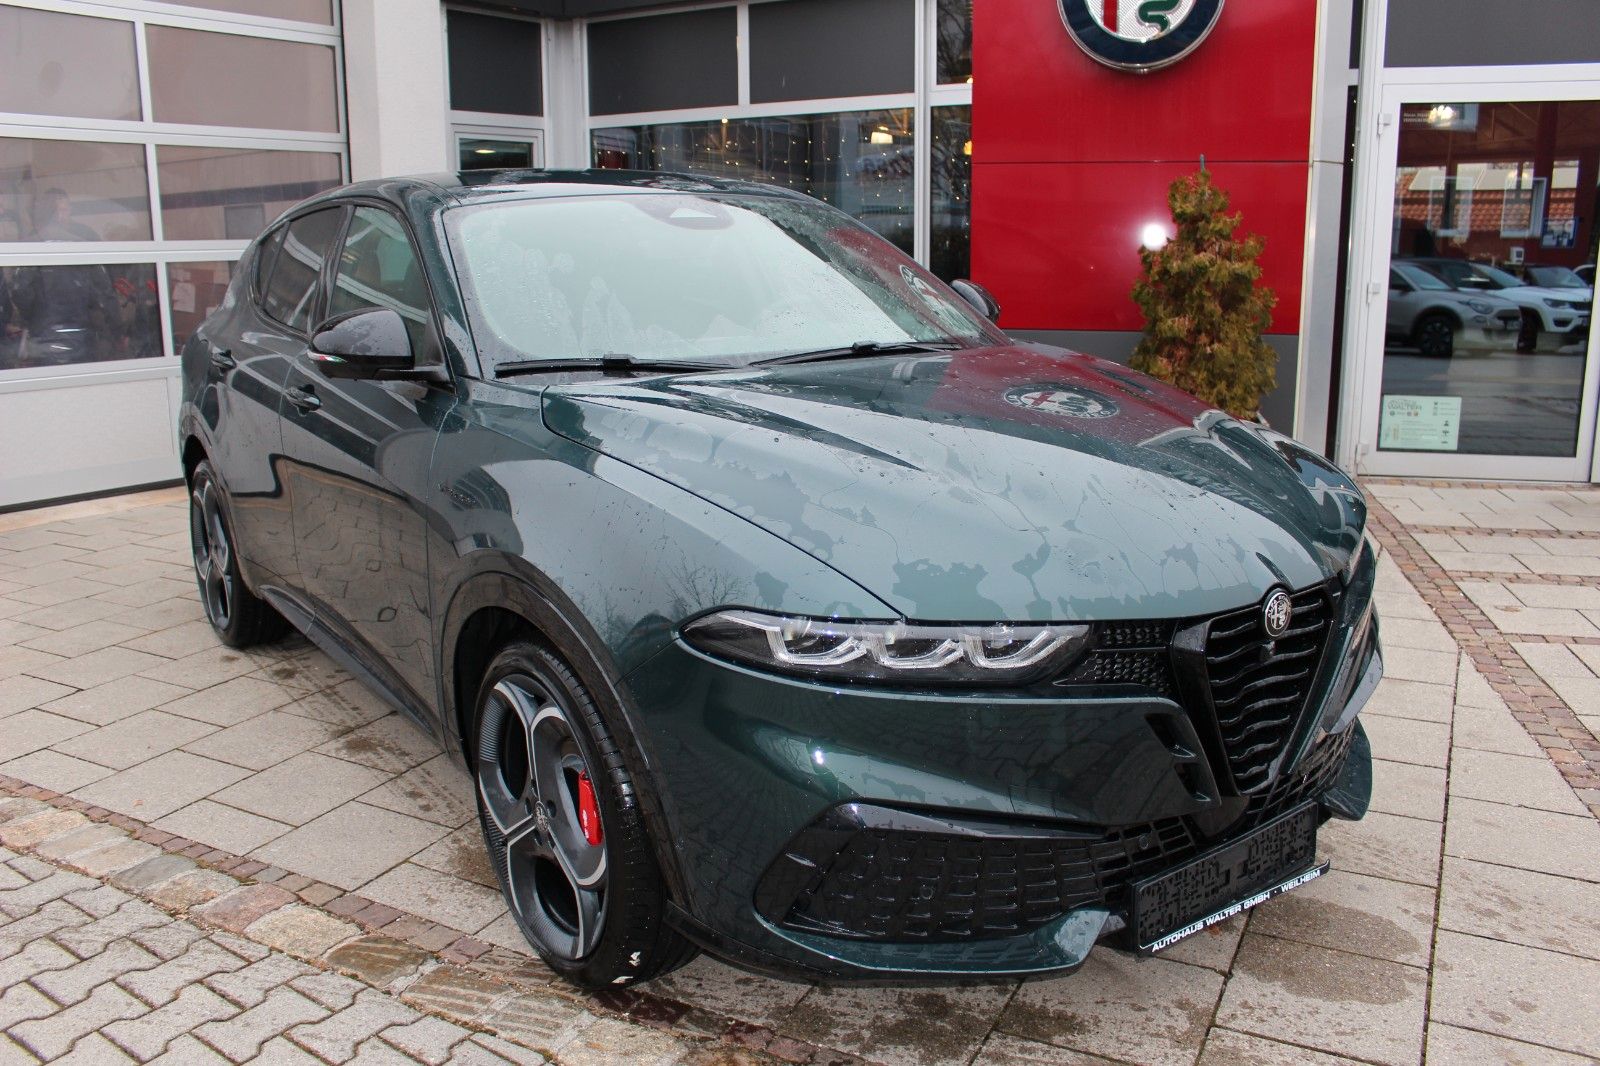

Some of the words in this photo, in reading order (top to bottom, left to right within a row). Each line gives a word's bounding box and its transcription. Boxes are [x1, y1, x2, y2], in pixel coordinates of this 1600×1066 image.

[1152, 922, 1204, 952] AUTOHAUS
[1205, 905, 1242, 926] WALTER
[1243, 892, 1271, 909] GMBH
[1281, 869, 1321, 892] WEILHEIM
